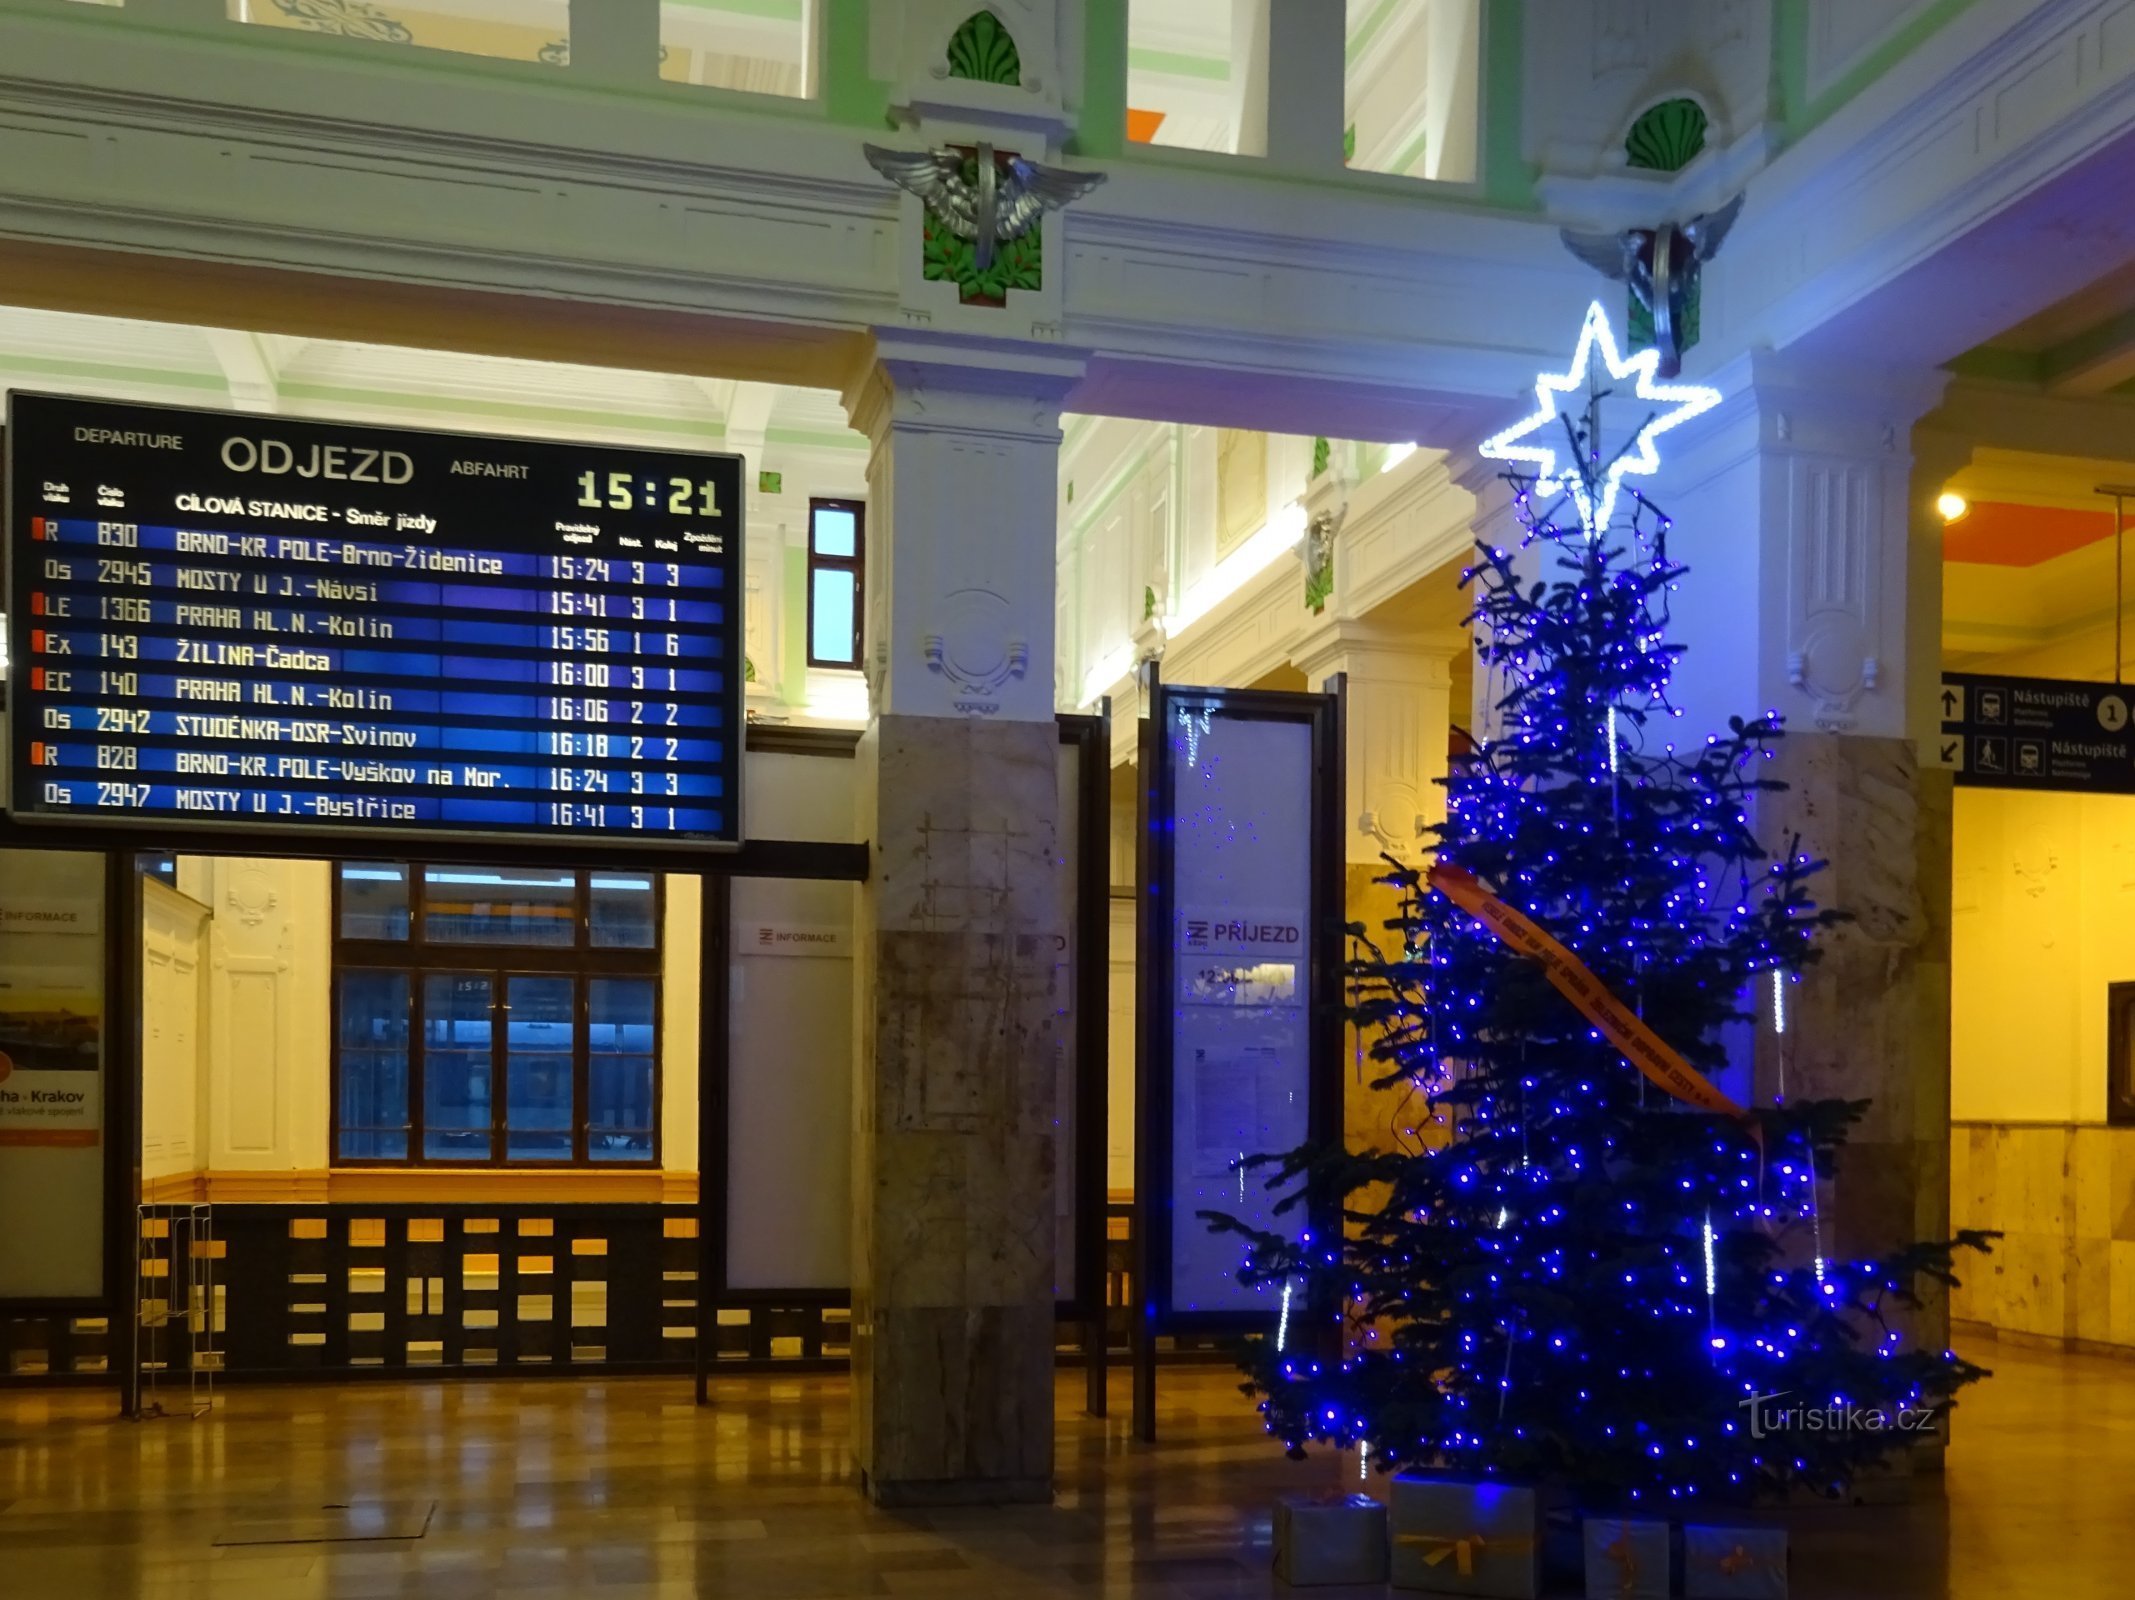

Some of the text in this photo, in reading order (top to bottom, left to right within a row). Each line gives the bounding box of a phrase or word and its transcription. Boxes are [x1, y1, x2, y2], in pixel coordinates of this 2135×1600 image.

[74, 427, 183, 450] DEPARTURE
[221, 436, 414, 485] ODJEZD
[450, 460, 530, 480] ABFAHRT
[577, 470, 722, 517] 15:21
[175, 493, 246, 516] CÍLOVÁ
[248, 501, 329, 522] STANICE
[346, 508, 391, 527] Směr
[45, 521, 59, 542] R
[97, 522, 138, 548] 830
[552, 555, 610, 583] 15:24
[631, 561, 645, 585] 3
[666, 563, 679, 587] 3
[45, 559, 72, 580] Os
[97, 559, 152, 586] 2945
[176, 568, 241, 592] MOSTY
[253, 574, 267, 594] U
[552, 591, 607, 618] 15:41
[631, 597, 645, 620] 3
[668, 599, 678, 622] 1
[45, 597, 72, 618] LE
[99, 598, 151, 623] 1366
[176, 605, 241, 629] PRAHA
[552, 626, 610, 653] 15:56
[633, 631, 642, 654] 1
[666, 633, 679, 657] 6
[45, 633, 677, 692] Ex 143 ŽILINA-Čadca 16:00 3 1
[45, 671, 72, 693] EC
[100, 671, 138, 696] 140
[176, 678, 241, 702] PRAHA
[551, 697, 609, 723] 16:06
[631, 702, 644, 725] 2
[666, 703, 678, 727] 2
[2013, 689, 2118, 723] Nástupiště 1
[44, 707, 71, 730] Os
[97, 708, 151, 734] 2942
[551, 732, 609, 758] 16:18
[631, 737, 644, 760] 2
[666, 739, 678, 762] 2
[2051, 741, 2127, 759] Nástupiště
[45, 745, 678, 797] R 828 BRNO-KR.POLE-Vyškov na Mor. 16:24 3 3
[45, 783, 72, 805] Os
[97, 783, 151, 808] 2947
[176, 789, 241, 812] MOSTY
[253, 793, 267, 813] U
[551, 803, 607, 828] 16:41
[631, 806, 644, 829] 3
[668, 808, 676, 831] 1
[4, 911, 78, 922] INFORMACE
[776, 933, 837, 943] INFORMACE
[1214, 920, 1299, 943] PŘÍJEZD
[31, 1089, 85, 1103] Krakov
